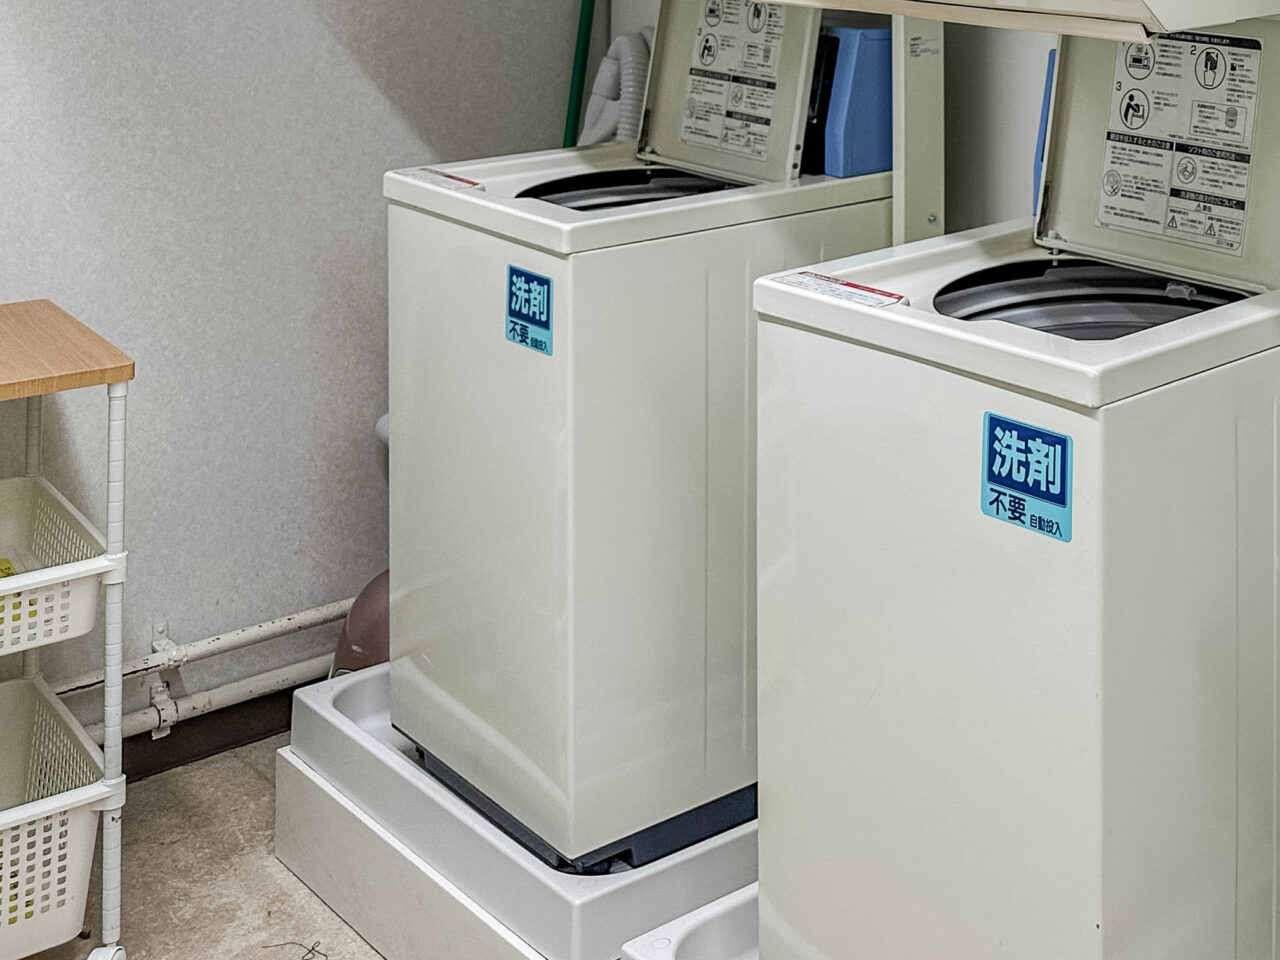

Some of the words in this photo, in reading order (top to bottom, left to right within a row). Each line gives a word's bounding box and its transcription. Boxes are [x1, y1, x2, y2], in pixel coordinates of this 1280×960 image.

[1190, 45, 1197, 55] 2
[1115, 81, 1122, 91] 3
[511, 275, 548, 322] 洗剤
[509, 320, 530, 345] 不要
[992, 426, 1061, 494] 洗剤
[989, 487, 1026, 525] 不要
[1030, 514, 1062, 537] 自動投入
